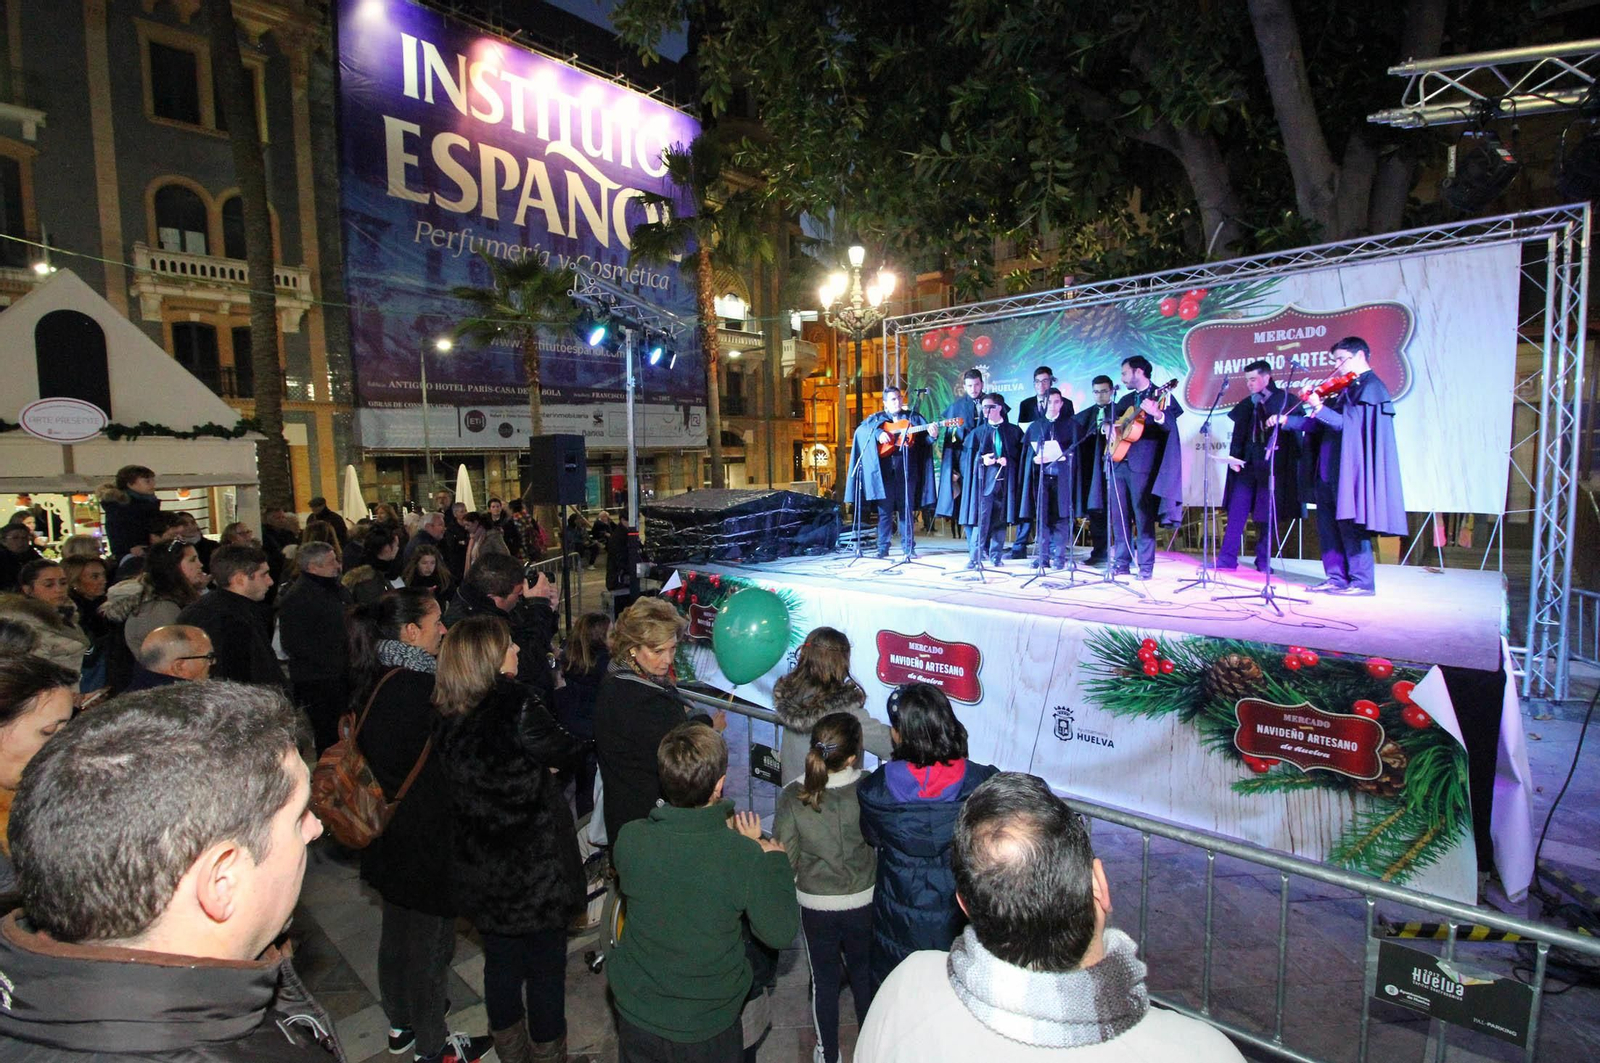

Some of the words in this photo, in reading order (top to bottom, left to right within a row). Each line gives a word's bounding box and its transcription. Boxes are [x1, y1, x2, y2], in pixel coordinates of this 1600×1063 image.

[382, 114, 682, 262] ESPAÑO
[414, 221, 550, 268] Perfumería
[1253, 325, 1327, 344] MERCADO
[435, 383, 465, 391] HOTEL
[541, 389, 561, 397] BOLA
[991, 383, 1025, 393] HUELVA
[908, 641, 943, 655] MERCADO
[890, 653, 924, 670] NAVIDEÑO
[925, 661, 964, 677] ARTESANO
[1283, 713, 1331, 729] MERCADO
[1076, 732, 1115, 749] HUELVA
[1256, 723, 1304, 741] NAVIDEÑO
[1307, 733, 1358, 752] ARTESANO
[1280, 743, 1292, 752] de
